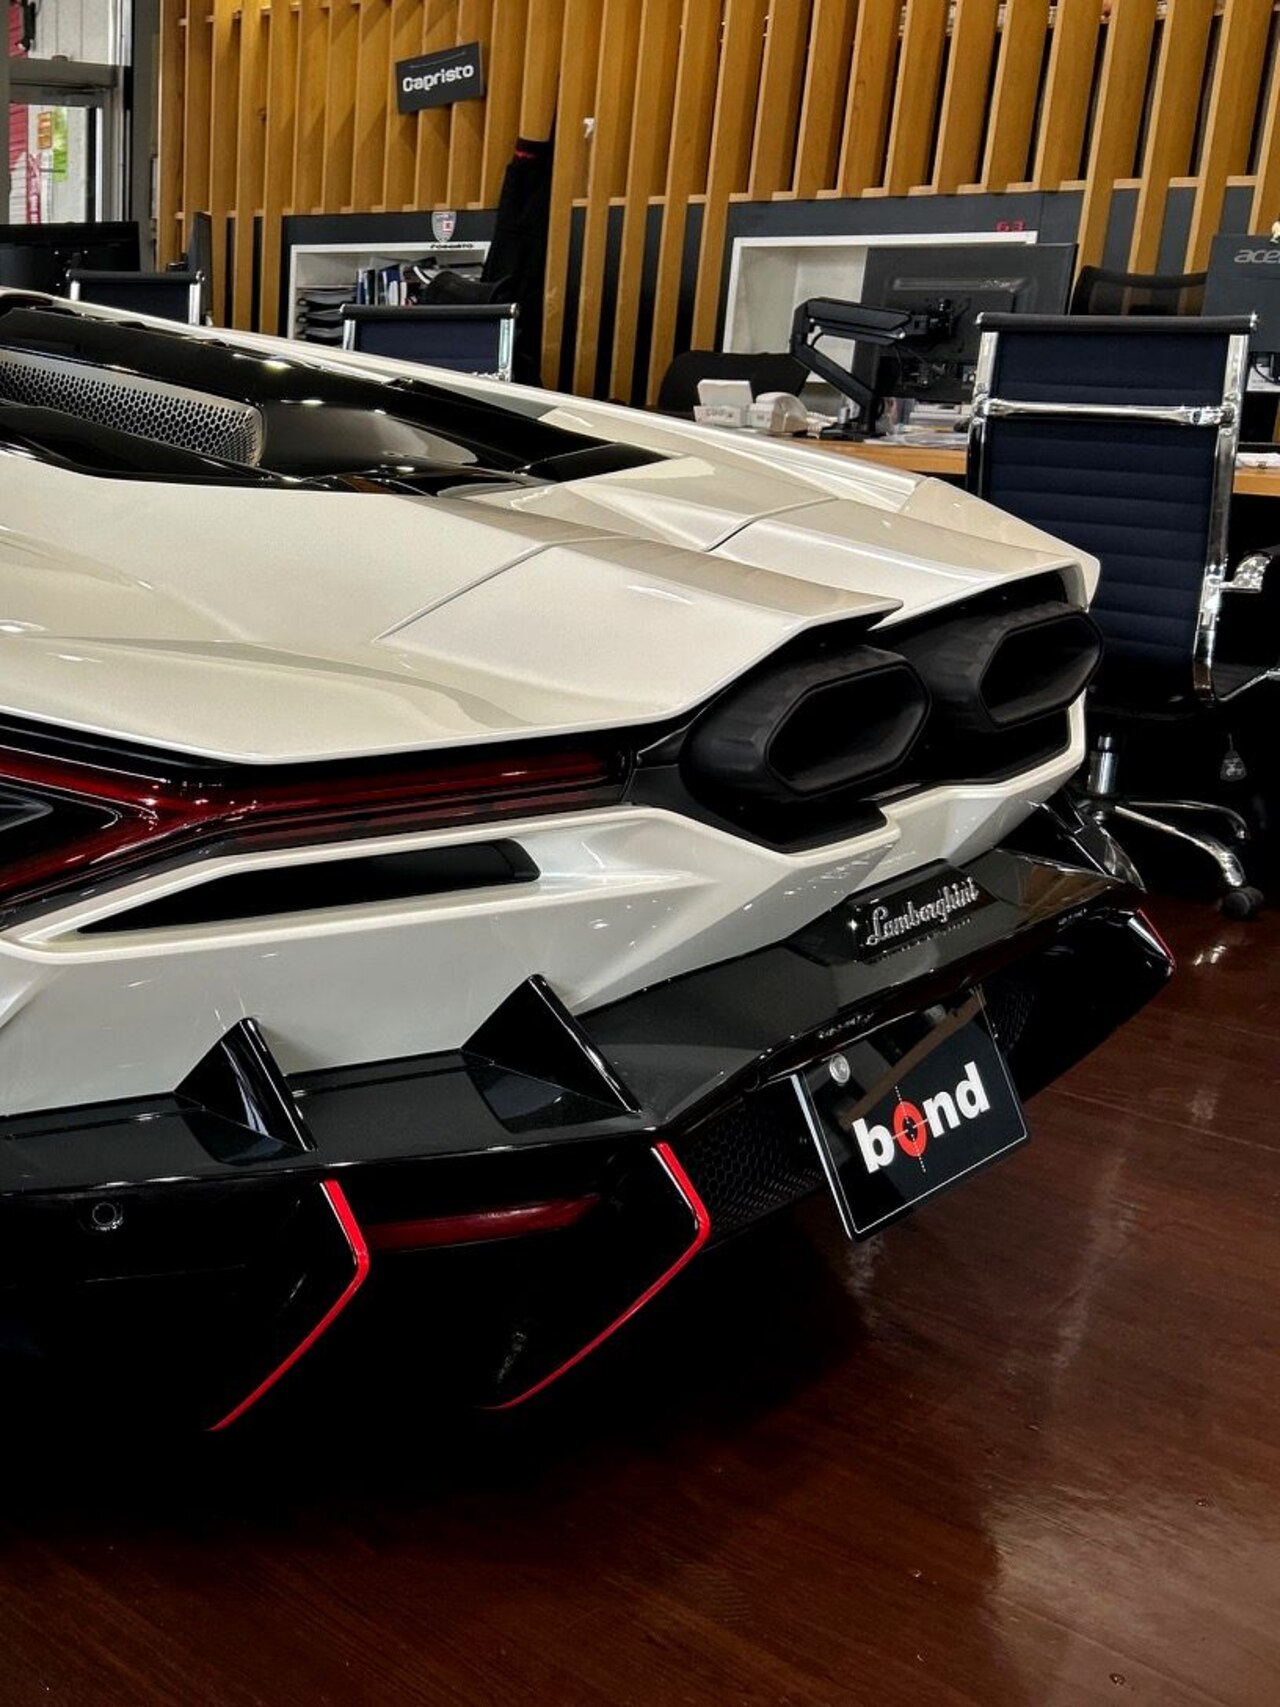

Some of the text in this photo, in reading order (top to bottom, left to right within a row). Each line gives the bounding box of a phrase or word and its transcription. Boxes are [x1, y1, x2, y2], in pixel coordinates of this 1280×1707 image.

[402, 64, 475, 92] Capristo
[1234, 249, 1280, 264] ace
[866, 876, 980, 946] Lamborghini
[852, 1061, 991, 1174] bond
